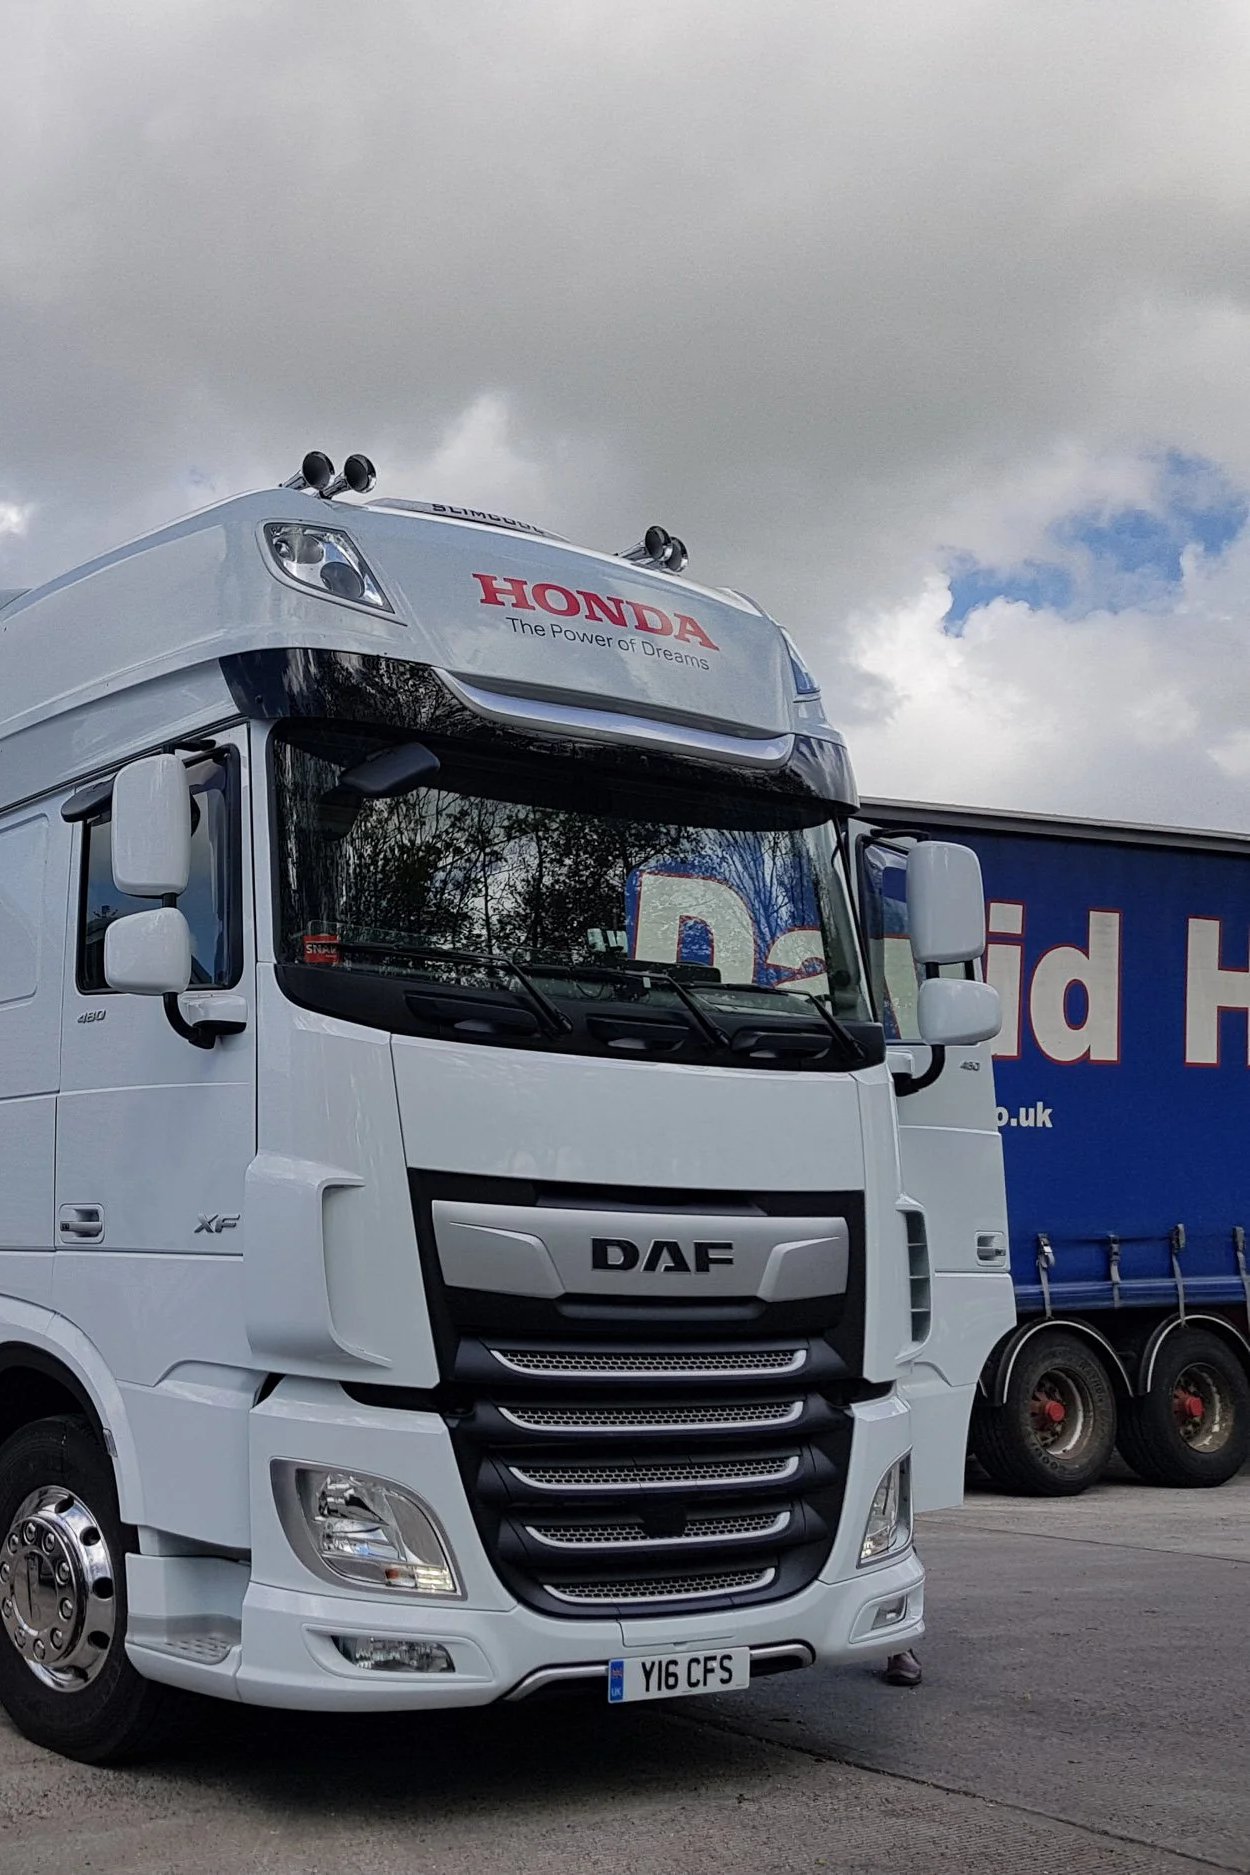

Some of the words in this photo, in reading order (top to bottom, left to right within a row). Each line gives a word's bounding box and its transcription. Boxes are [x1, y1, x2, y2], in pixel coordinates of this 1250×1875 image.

[472, 573, 719, 651] HONDA
[506, 617, 545, 637] The
[550, 623, 613, 648] Power
[618, 638, 637, 653] of
[642, 641, 710, 670] Dreams
[77, 1010, 106, 1024] 480
[194, 1213, 241, 1234] XF
[590, 1236, 734, 1273] DAF
[641, 1659, 679, 1692] Y16
[687, 1654, 733, 1688] CFS
